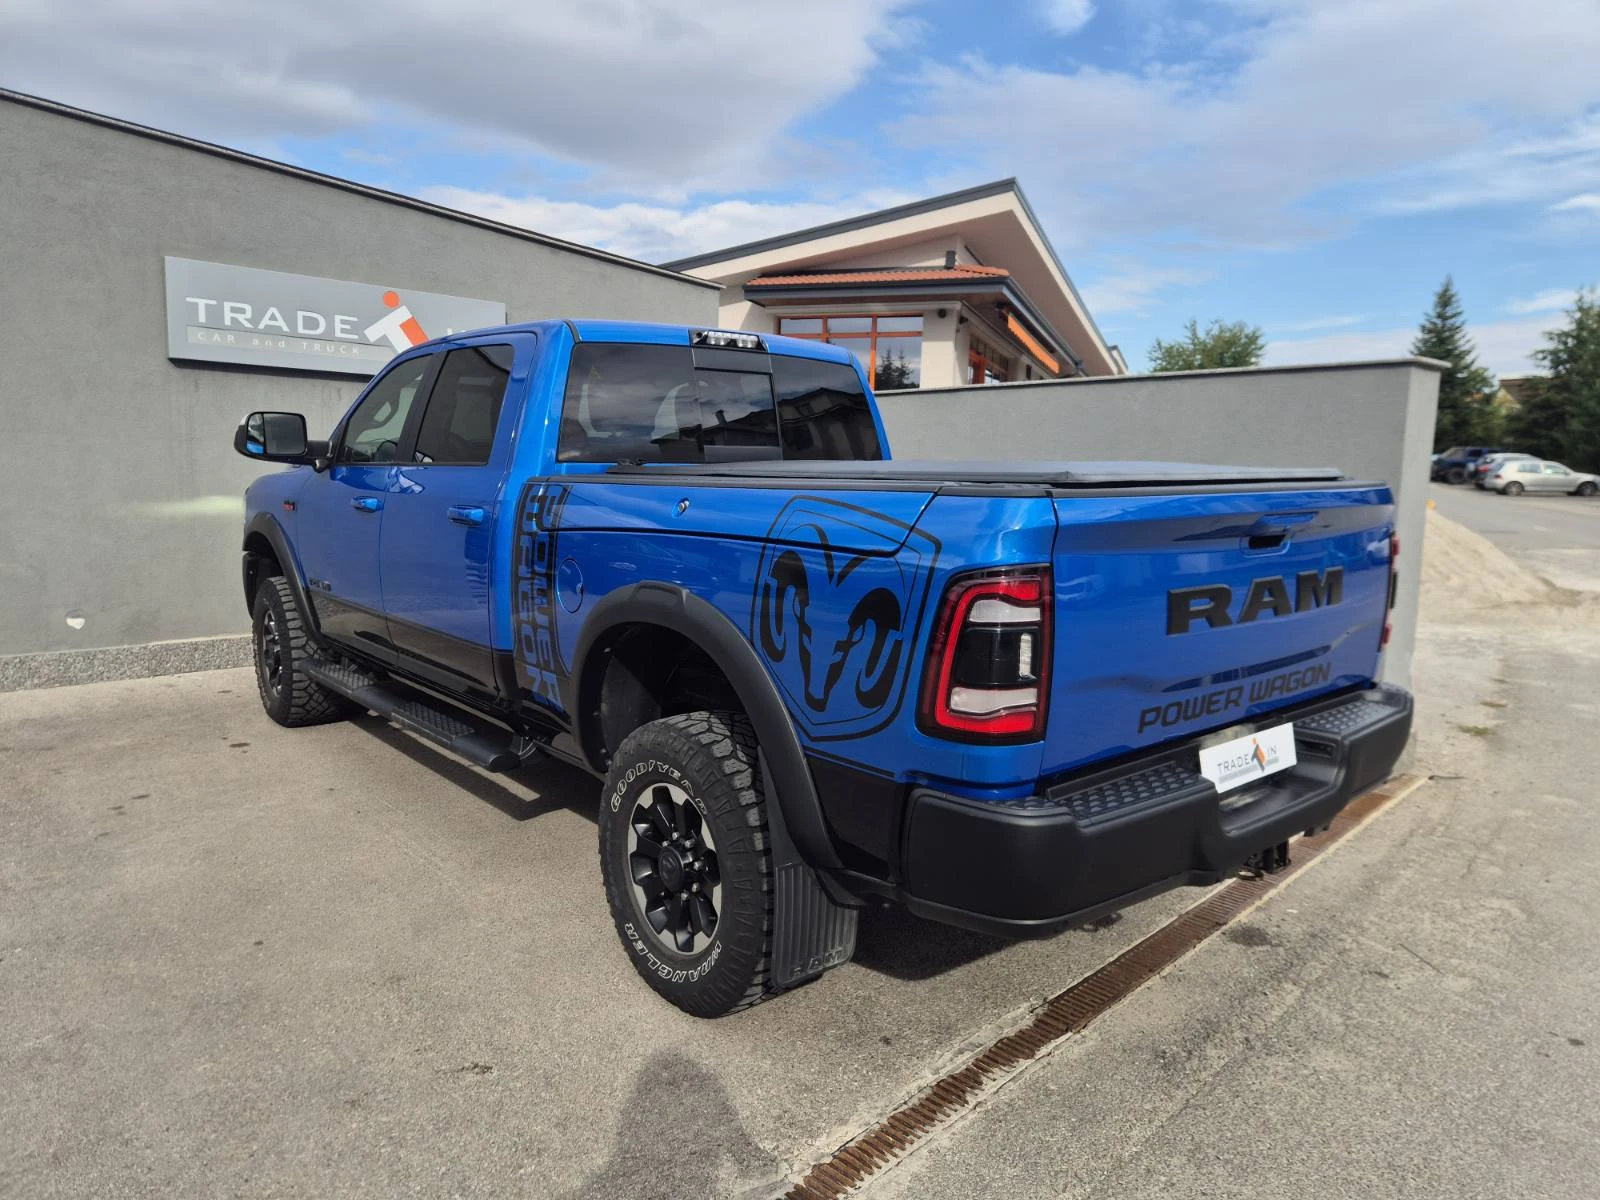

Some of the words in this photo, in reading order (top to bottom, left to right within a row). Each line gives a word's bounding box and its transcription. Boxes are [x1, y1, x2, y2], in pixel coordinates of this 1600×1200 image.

[186, 297, 360, 339] TRADE
[197, 331, 236, 344] CAR
[253, 337, 286, 348] and
[302, 342, 361, 355] TRUCK
[1166, 565, 1345, 636] RAM
[1137, 683, 1243, 734] POWER
[1249, 662, 1332, 704] WAGON
[610, 759, 708, 816] GOODYEAR
[1217, 753, 1251, 775] TRADE
[1266, 744, 1278, 757] IN
[624, 922, 724, 984] WRANGLER
